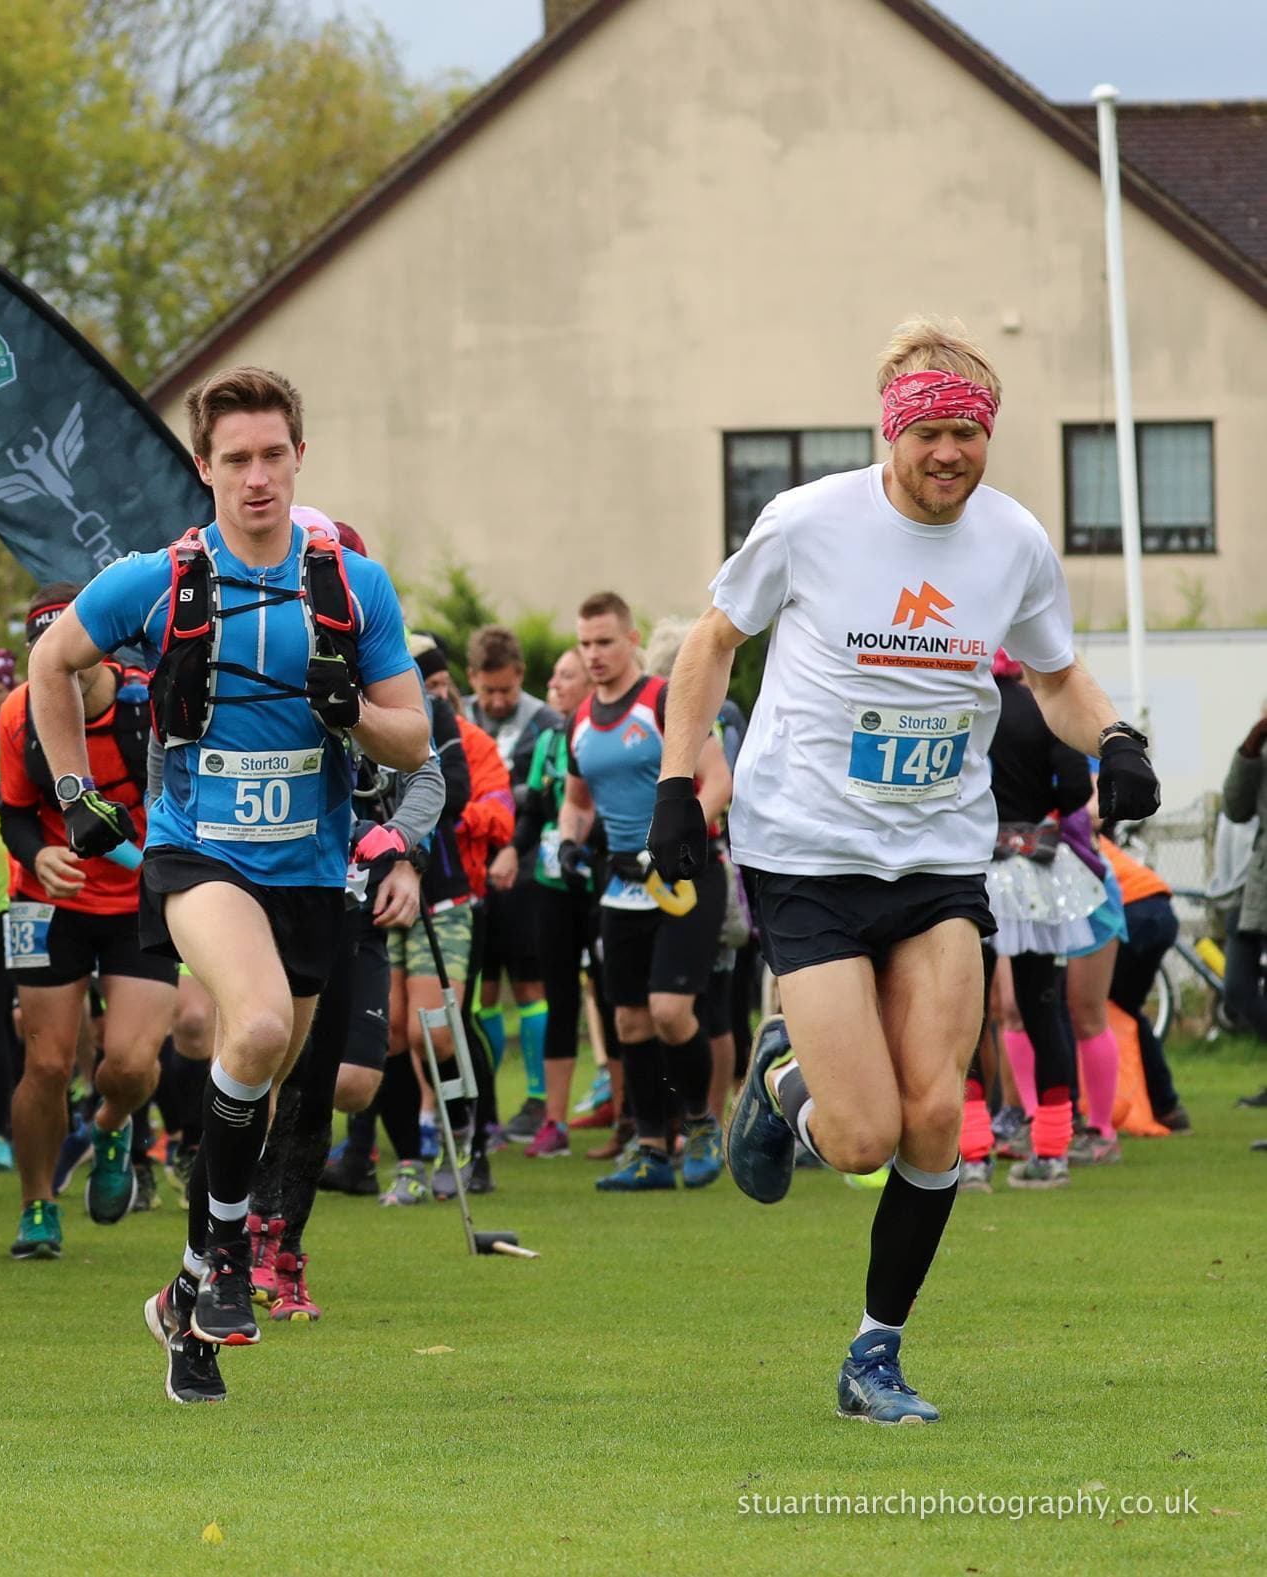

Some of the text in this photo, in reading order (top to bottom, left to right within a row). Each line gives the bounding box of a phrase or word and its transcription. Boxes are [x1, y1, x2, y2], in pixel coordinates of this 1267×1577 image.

[847, 632, 988, 656] MOUNTAINFUEL
[861, 655, 972, 670] Peak Performance Nutrition
[899, 714, 947, 730] Stort30
[241, 757, 289, 771] Stort30
[877, 737, 954, 784] 149
[234, 779, 291, 824] 50
